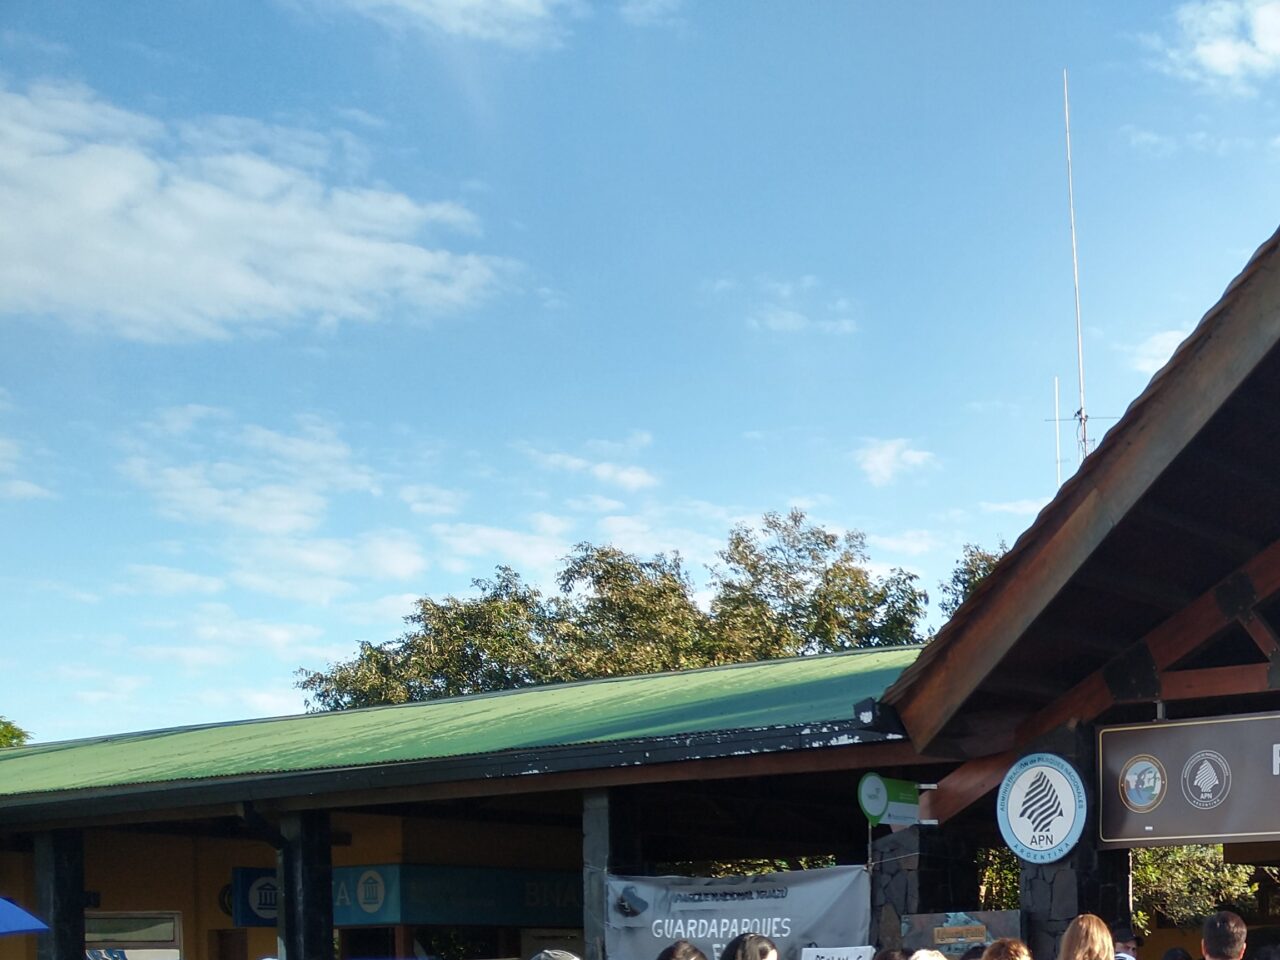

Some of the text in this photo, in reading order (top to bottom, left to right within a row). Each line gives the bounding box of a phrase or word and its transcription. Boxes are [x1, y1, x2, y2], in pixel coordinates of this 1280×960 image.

[1029, 834, 1054, 846] APN
[1013, 843, 1071, 860] ARGENTINA
[651, 917, 792, 939] GUARDAPARQUES
